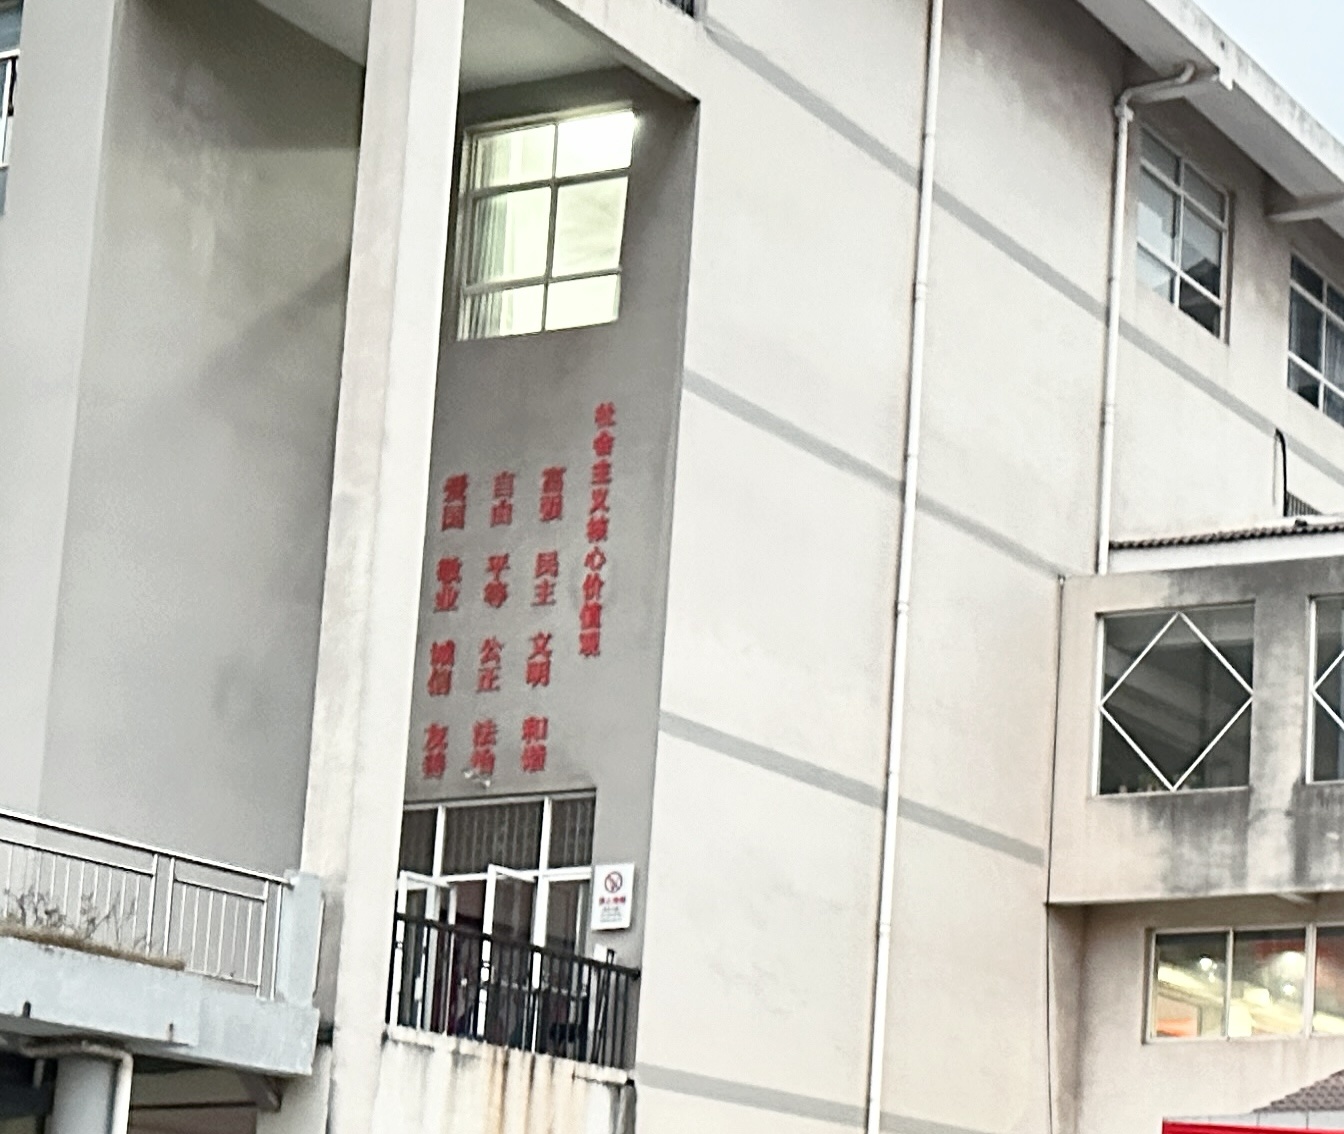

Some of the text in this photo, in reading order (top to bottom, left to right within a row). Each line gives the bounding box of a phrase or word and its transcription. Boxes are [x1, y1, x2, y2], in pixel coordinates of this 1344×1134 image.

[490, 471, 516, 527] 自由
[578, 401, 616, 657] 社会主义核心价值观
[531, 550, 559, 606] 民主
[476, 636, 504, 693] 公正
[525, 630, 553, 687] 文明
